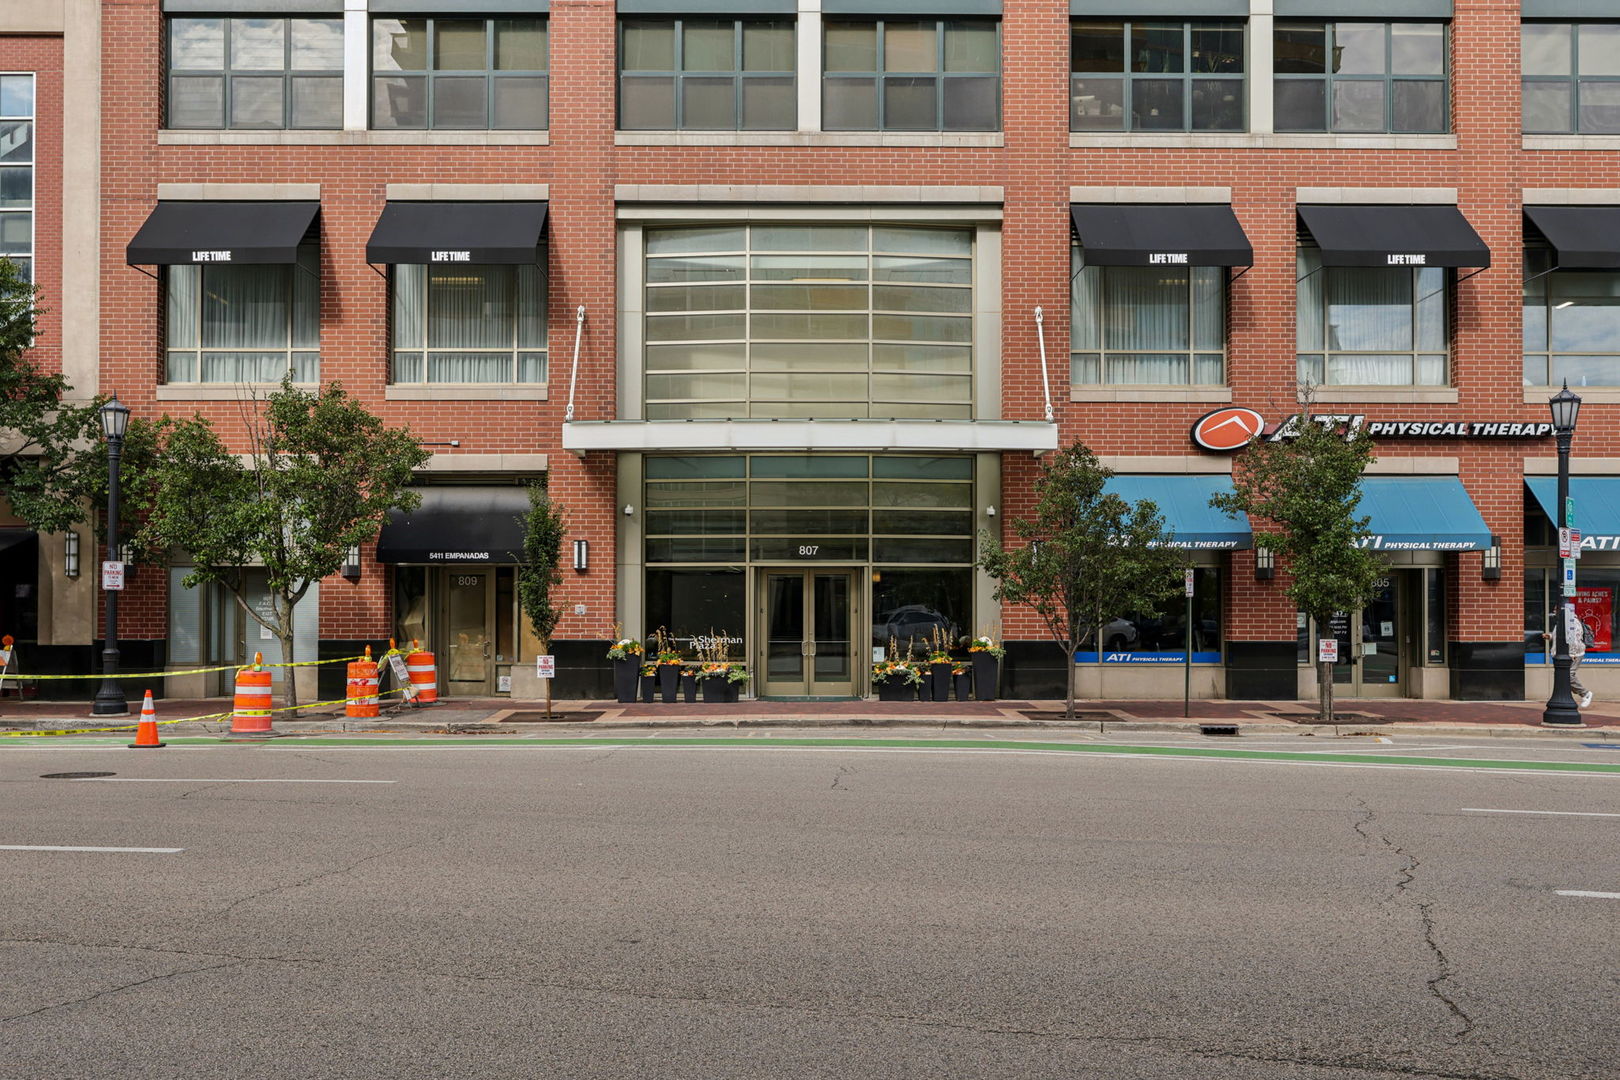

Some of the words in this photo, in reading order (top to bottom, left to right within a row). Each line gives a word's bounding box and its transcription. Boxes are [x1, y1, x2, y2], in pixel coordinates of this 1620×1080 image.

[192, 251, 210, 261] LIFE
[210, 251, 231, 261] TIME
[431, 251, 449, 261] LIFE
[449, 251, 470, 261] TIME
[1149, 253, 1167, 264] LIFE
[1167, 253, 1188, 264] TIME
[1387, 254, 1404, 264] LIFE
[1404, 254, 1426, 264] TIME
[1369, 422, 1467, 436] PHYSICAL
[1194, 541, 1238, 549] THERAPY
[1384, 541, 1431, 549] PHYSICAL
[1432, 541, 1476, 549] THERAPY
[1579, 535, 1620, 550] ATI
[799, 545, 819, 555] 807
[458, 576, 478, 586] 809
[698, 635, 743, 644] Sheman
[1106, 653, 1132, 662] ATI
